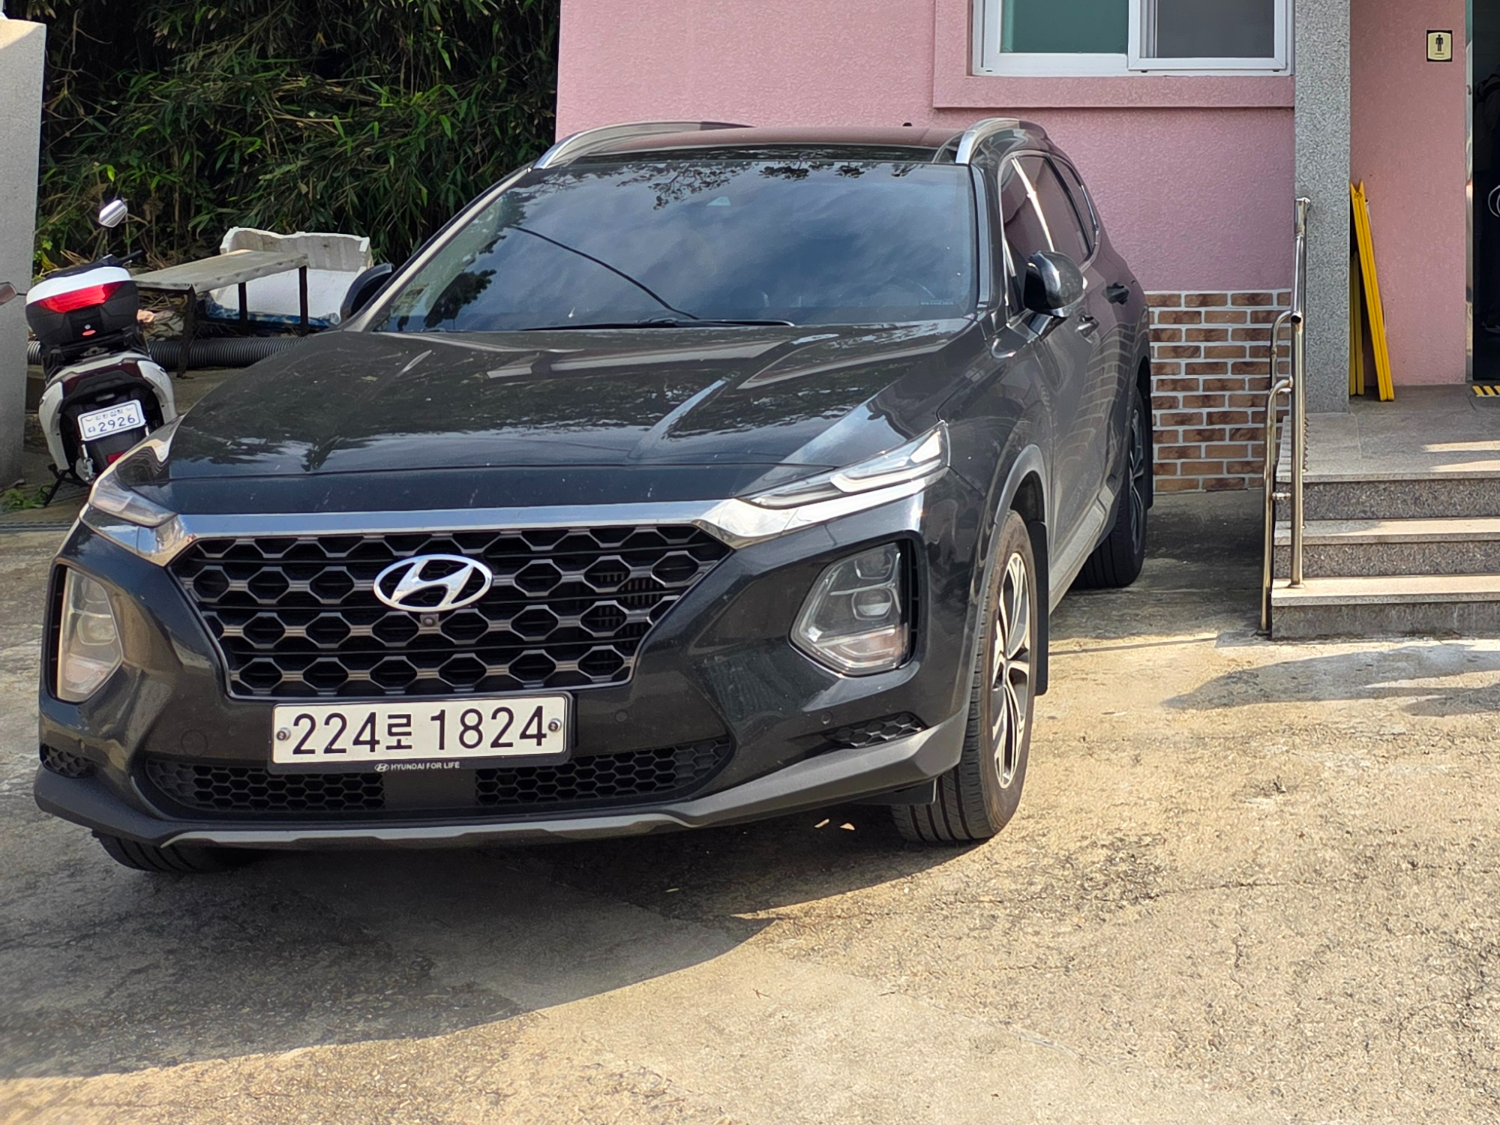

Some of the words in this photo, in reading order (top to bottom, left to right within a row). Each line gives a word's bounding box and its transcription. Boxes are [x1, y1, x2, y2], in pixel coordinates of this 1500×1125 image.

[291, 711, 413, 756] 224로
[429, 705, 548, 751] 1824
[390, 763, 425, 771] HYUNDAI
[426, 762, 442, 770] FOR
[443, 761, 460, 769] LIFE
